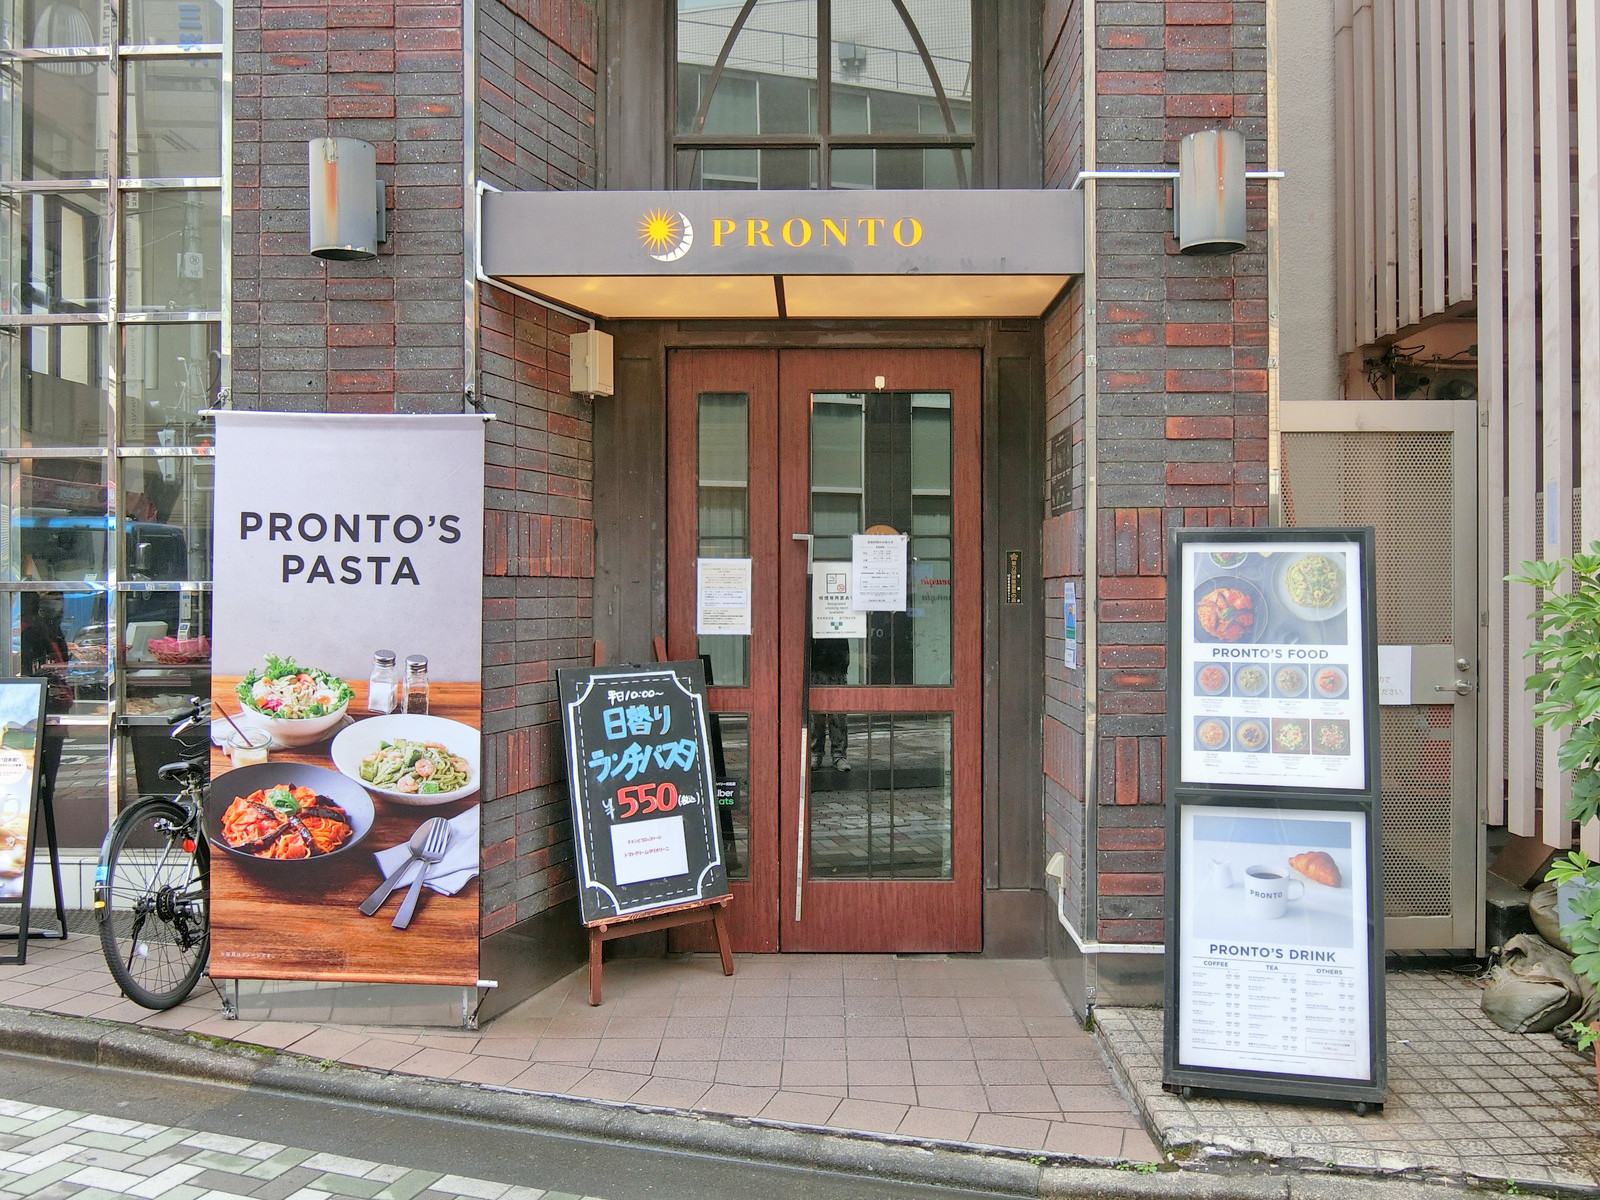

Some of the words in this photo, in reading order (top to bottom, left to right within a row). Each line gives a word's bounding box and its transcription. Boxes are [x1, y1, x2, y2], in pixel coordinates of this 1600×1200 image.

[711, 216, 925, 248] PRONTO
[240, 511, 462, 544] PRONTO'S
[282, 554, 420, 586] PASTA
[1213, 647, 1283, 659] PRONTO'S
[1288, 649, 1329, 660] FOOD
[602, 704, 671, 740] 日替り
[588, 738, 697, 783] ランチパスタ
[718, 798, 735, 806] ats
[1250, 889, 1283, 899] PRONTO
[1203, 960, 1229, 968] COFFEE
[1210, 944, 1284, 959] PRONTO'S
[1289, 949, 1336, 962] DRINK
